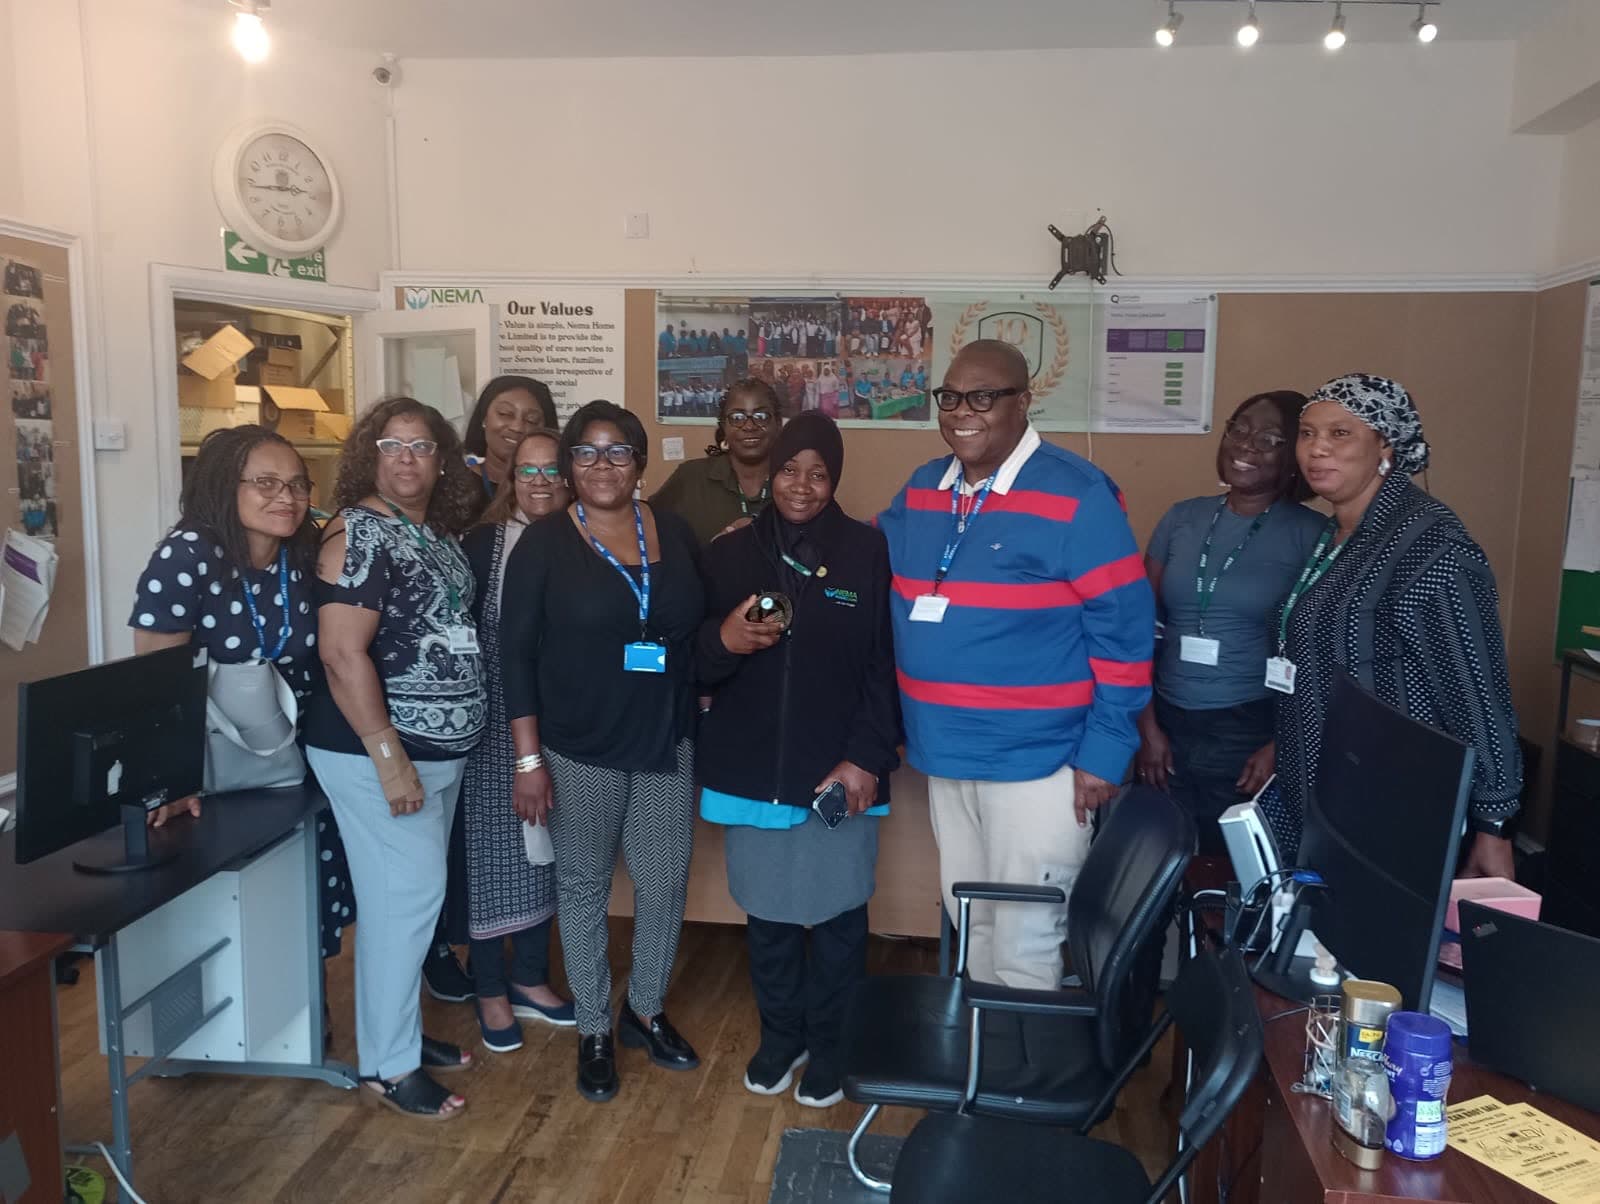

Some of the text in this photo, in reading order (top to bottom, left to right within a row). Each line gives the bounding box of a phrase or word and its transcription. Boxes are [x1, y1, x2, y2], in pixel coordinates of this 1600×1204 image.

[297, 264, 324, 278] exit
[431, 288, 484, 304] NEMA
[507, 300, 594, 316] Our Values
[592, 321, 615, 330] Home
[508, 332, 538, 340] Limited
[540, 332, 547, 340] is
[558, 332, 588, 342] provide
[590, 333, 603, 341] the
[516, 344, 542, 353] quality
[545, 344, 553, 352] of
[514, 355, 545, 363] Service
